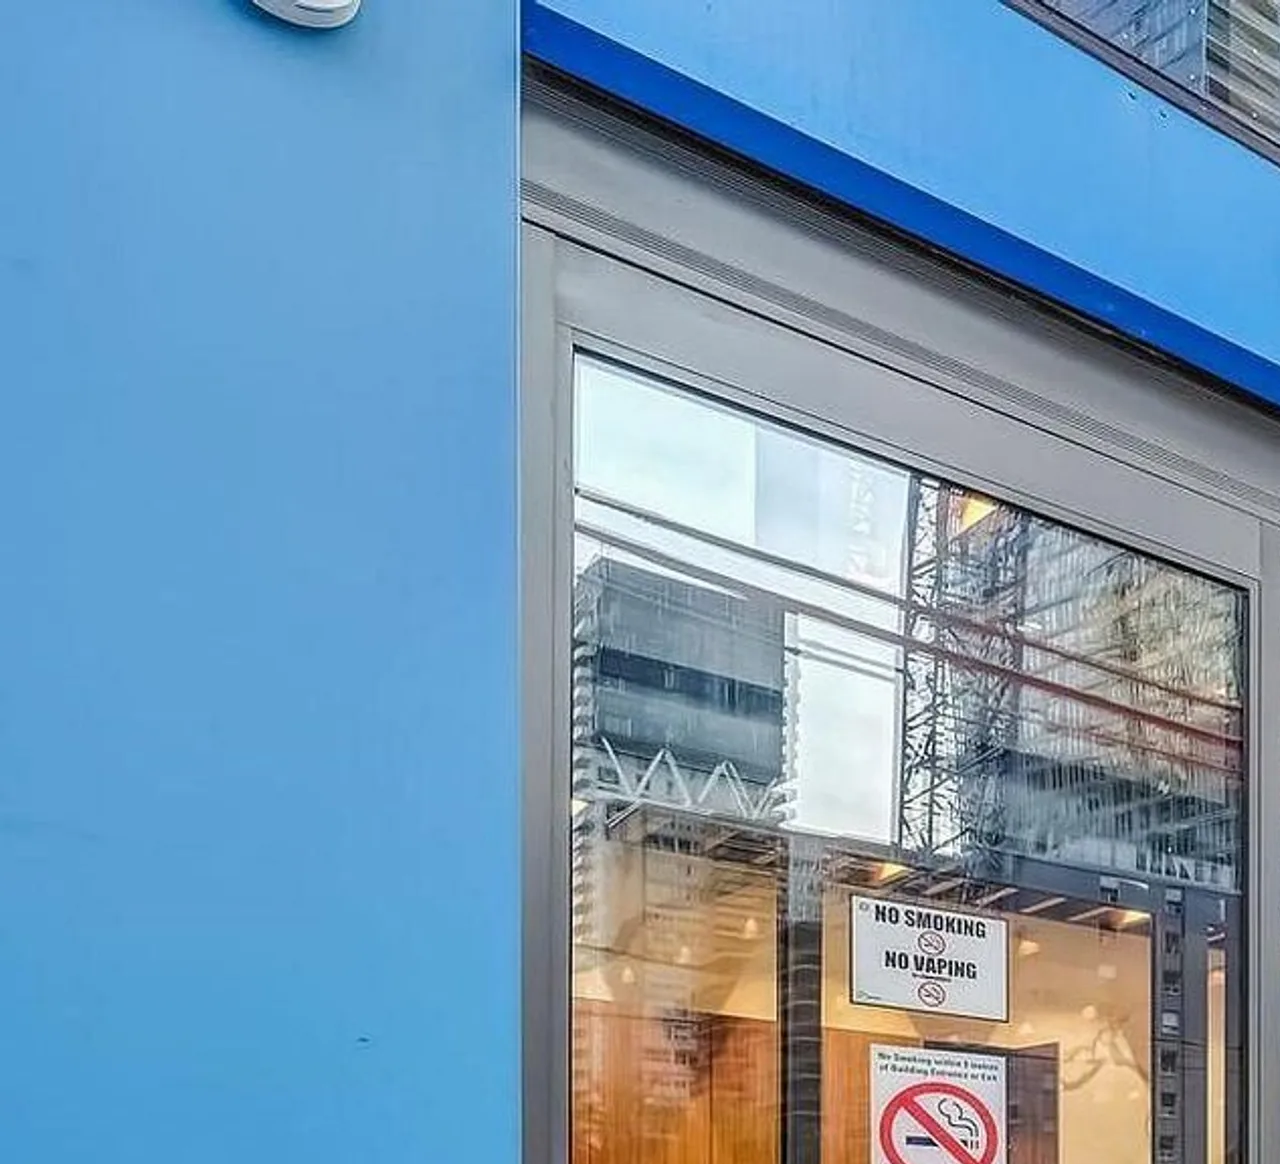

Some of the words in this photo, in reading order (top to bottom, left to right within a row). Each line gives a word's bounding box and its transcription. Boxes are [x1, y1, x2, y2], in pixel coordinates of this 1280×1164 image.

[874, 904, 900, 925] NO
[904, 909, 987, 939] SMOKING
[884, 949, 909, 970] NO
[913, 954, 978, 980] VAPING
